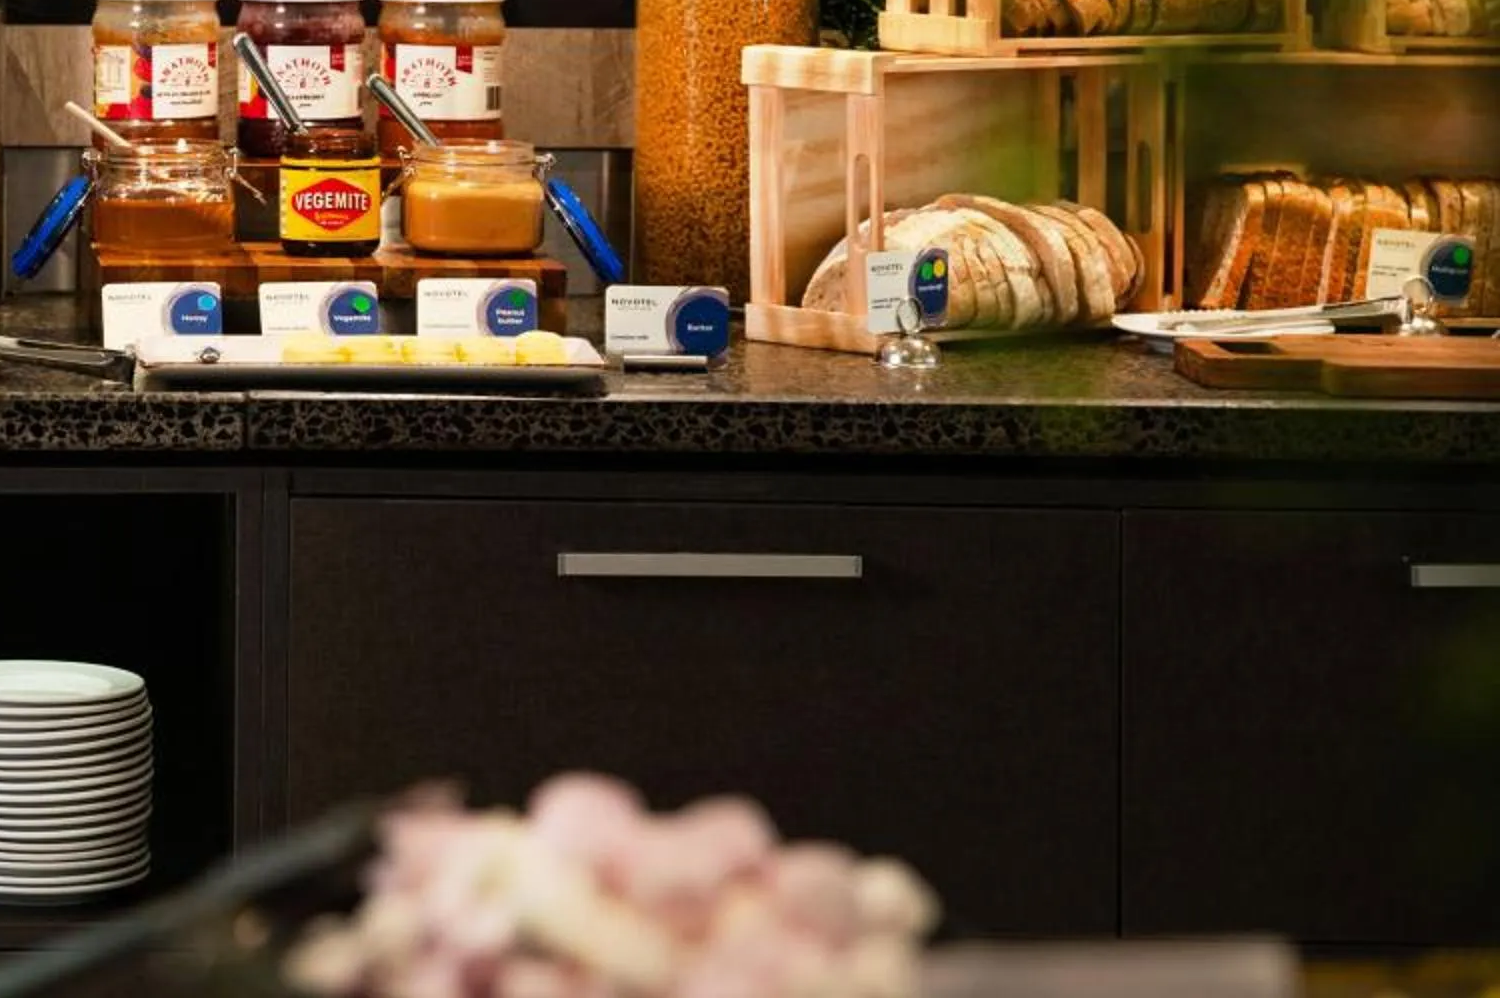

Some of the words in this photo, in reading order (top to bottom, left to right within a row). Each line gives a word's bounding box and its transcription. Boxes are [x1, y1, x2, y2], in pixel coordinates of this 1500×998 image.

[276, 58, 332, 86] NATHOTH
[295, 192, 368, 211] VEGEMITE
[611, 297, 658, 306] NOVOTEL
